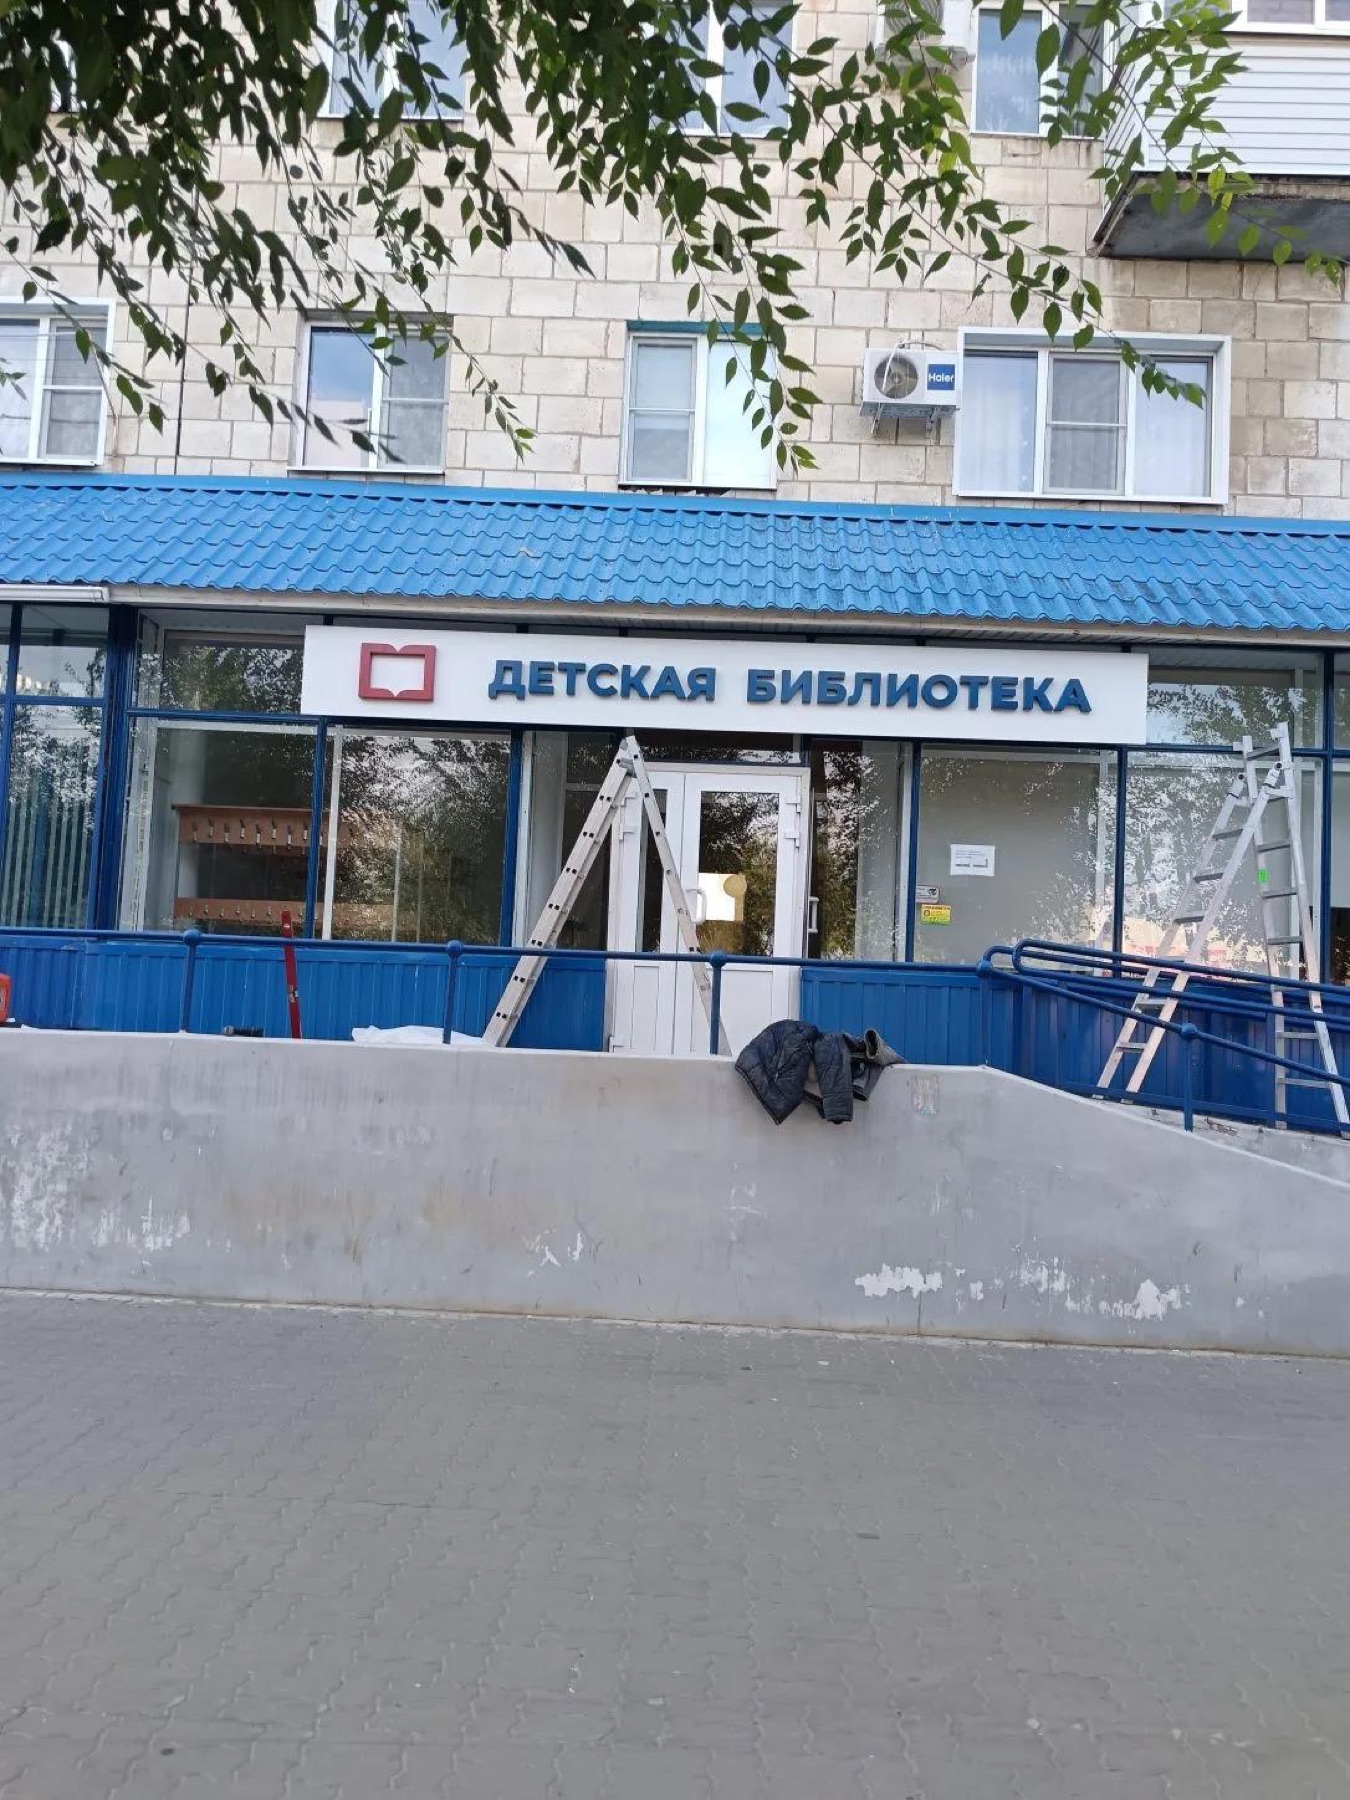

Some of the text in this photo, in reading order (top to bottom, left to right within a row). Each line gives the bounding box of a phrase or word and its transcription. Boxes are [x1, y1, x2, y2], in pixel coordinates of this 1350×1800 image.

[928, 372, 955, 382] Haier
[488, 660, 1092, 713] ДЕТСКАЯ БИБЛИОТЕКА
